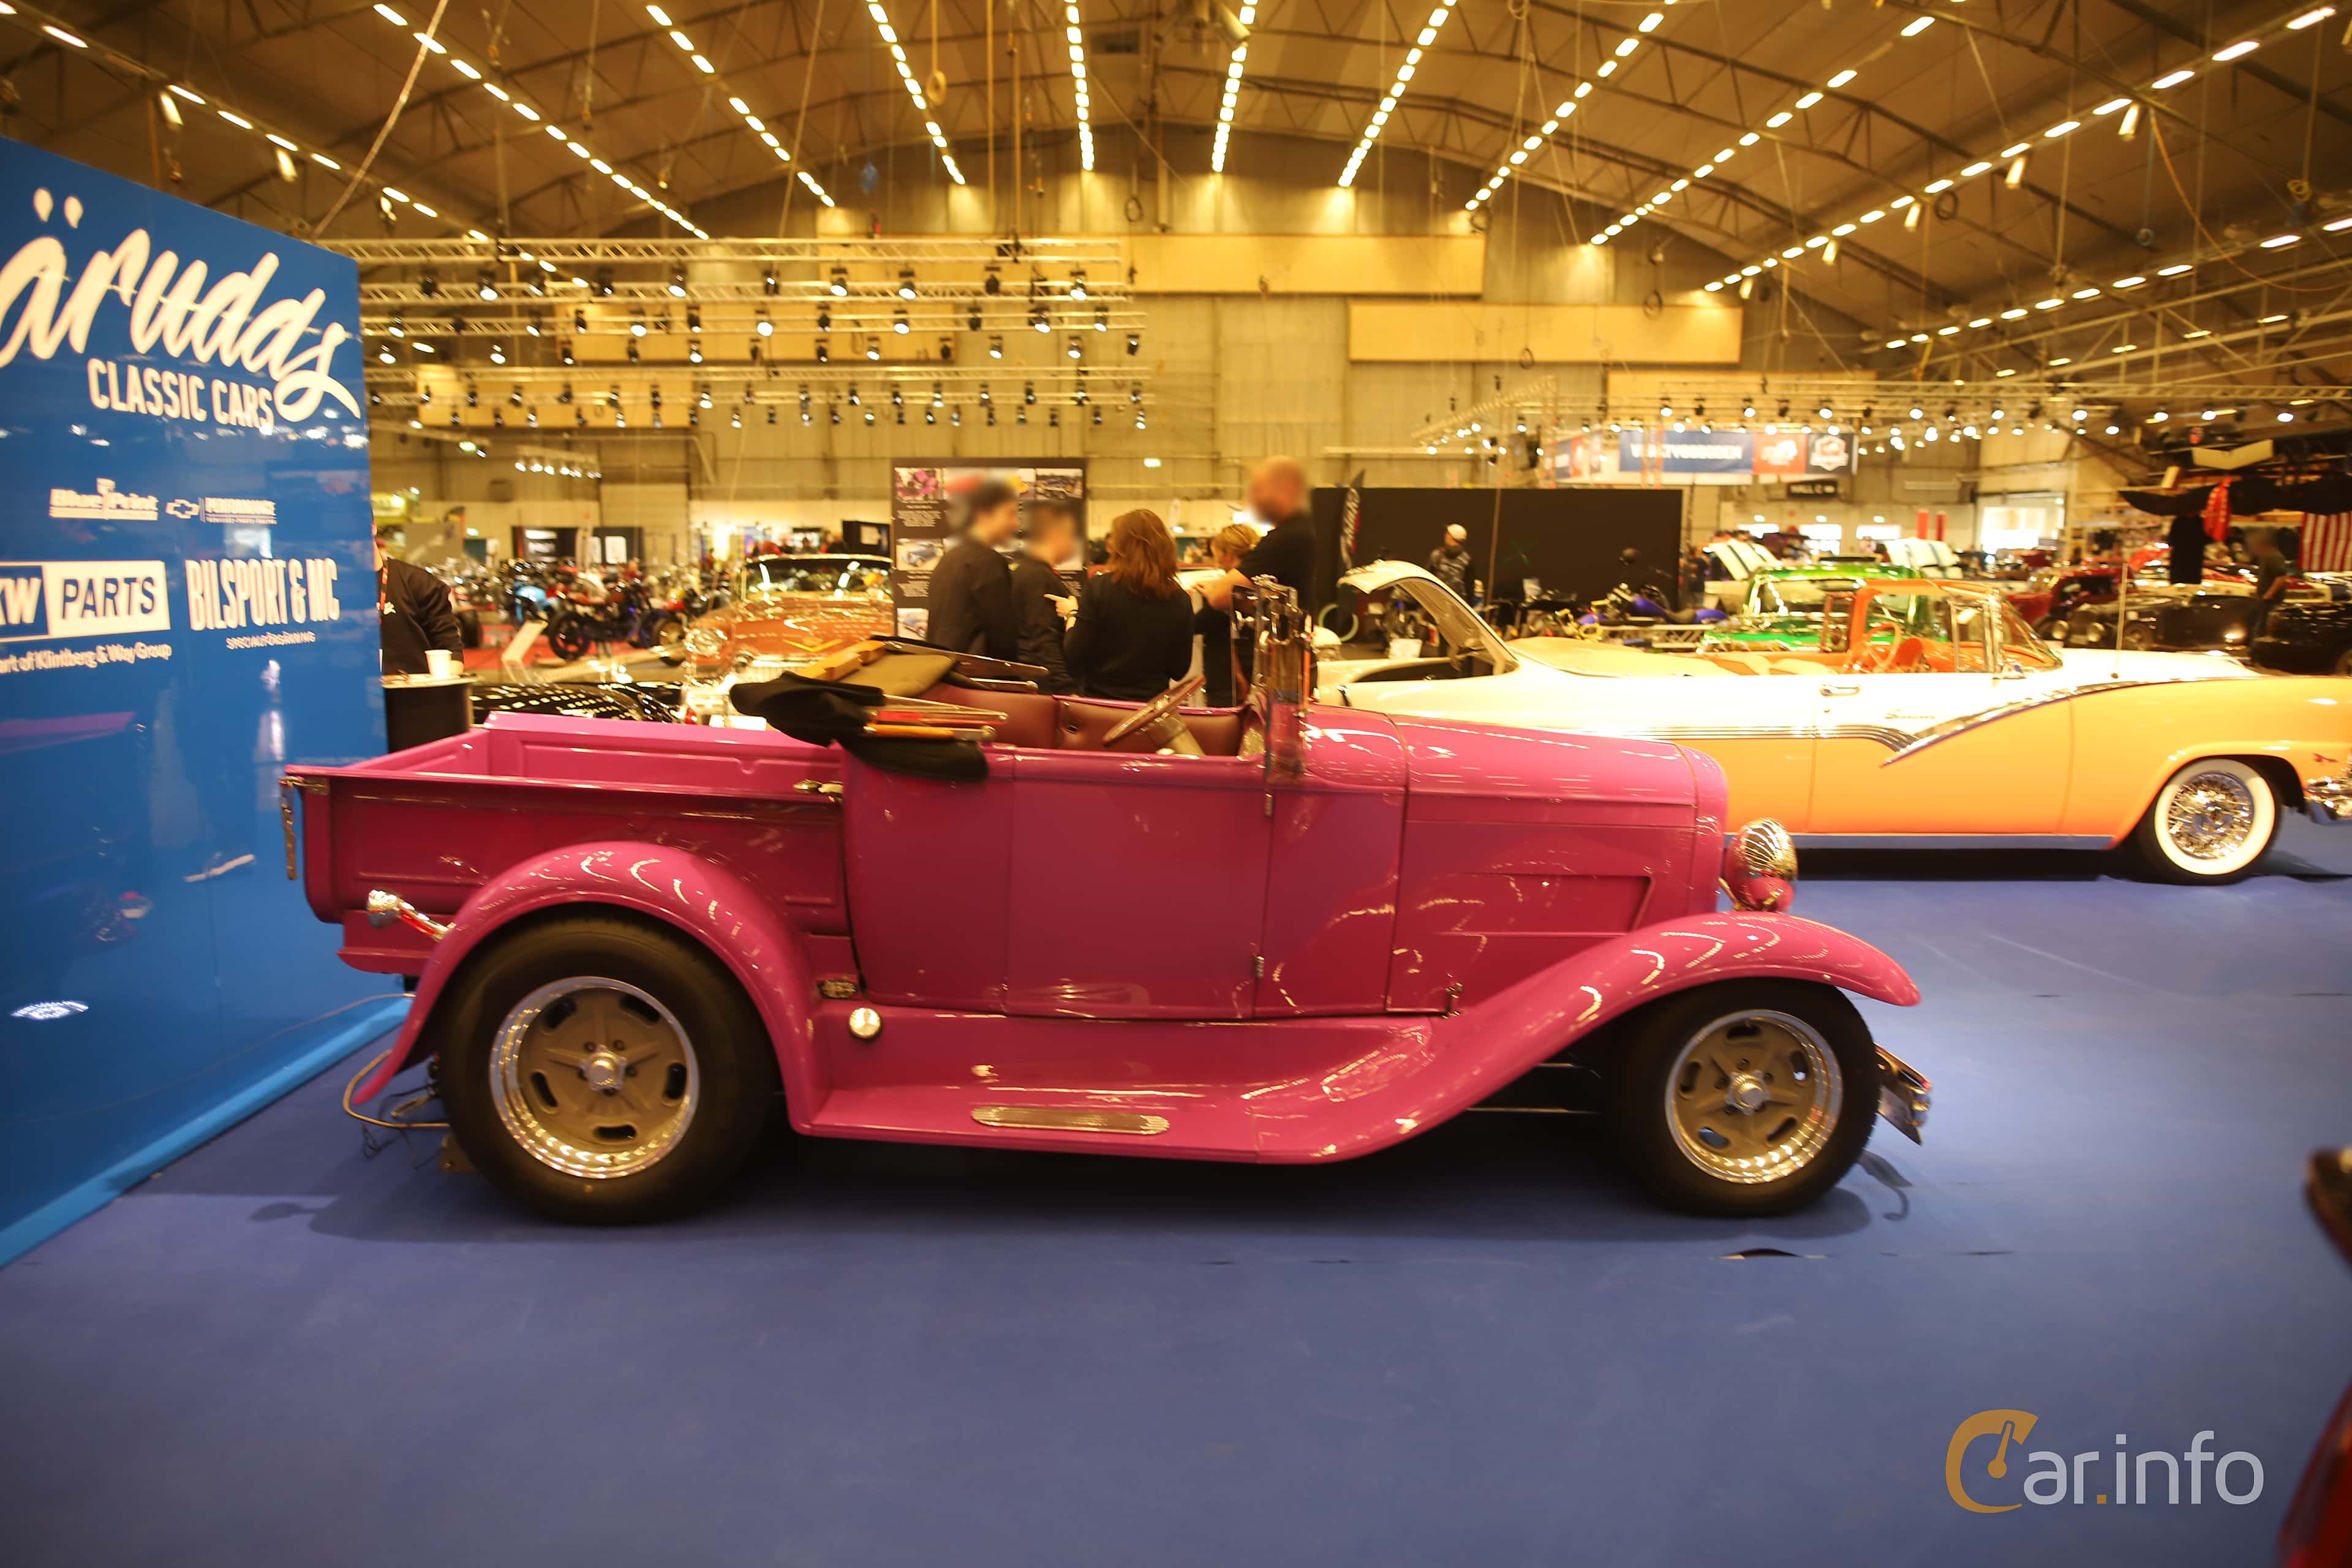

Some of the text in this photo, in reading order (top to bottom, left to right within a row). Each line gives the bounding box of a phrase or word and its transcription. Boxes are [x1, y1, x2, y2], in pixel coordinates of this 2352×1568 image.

[88, 358, 275, 429] CLASSIC CARS
[62, 577, 156, 619] PARTS
[185, 557, 341, 631] BILSPORT & MC
[134, 641, 172, 660] Group
